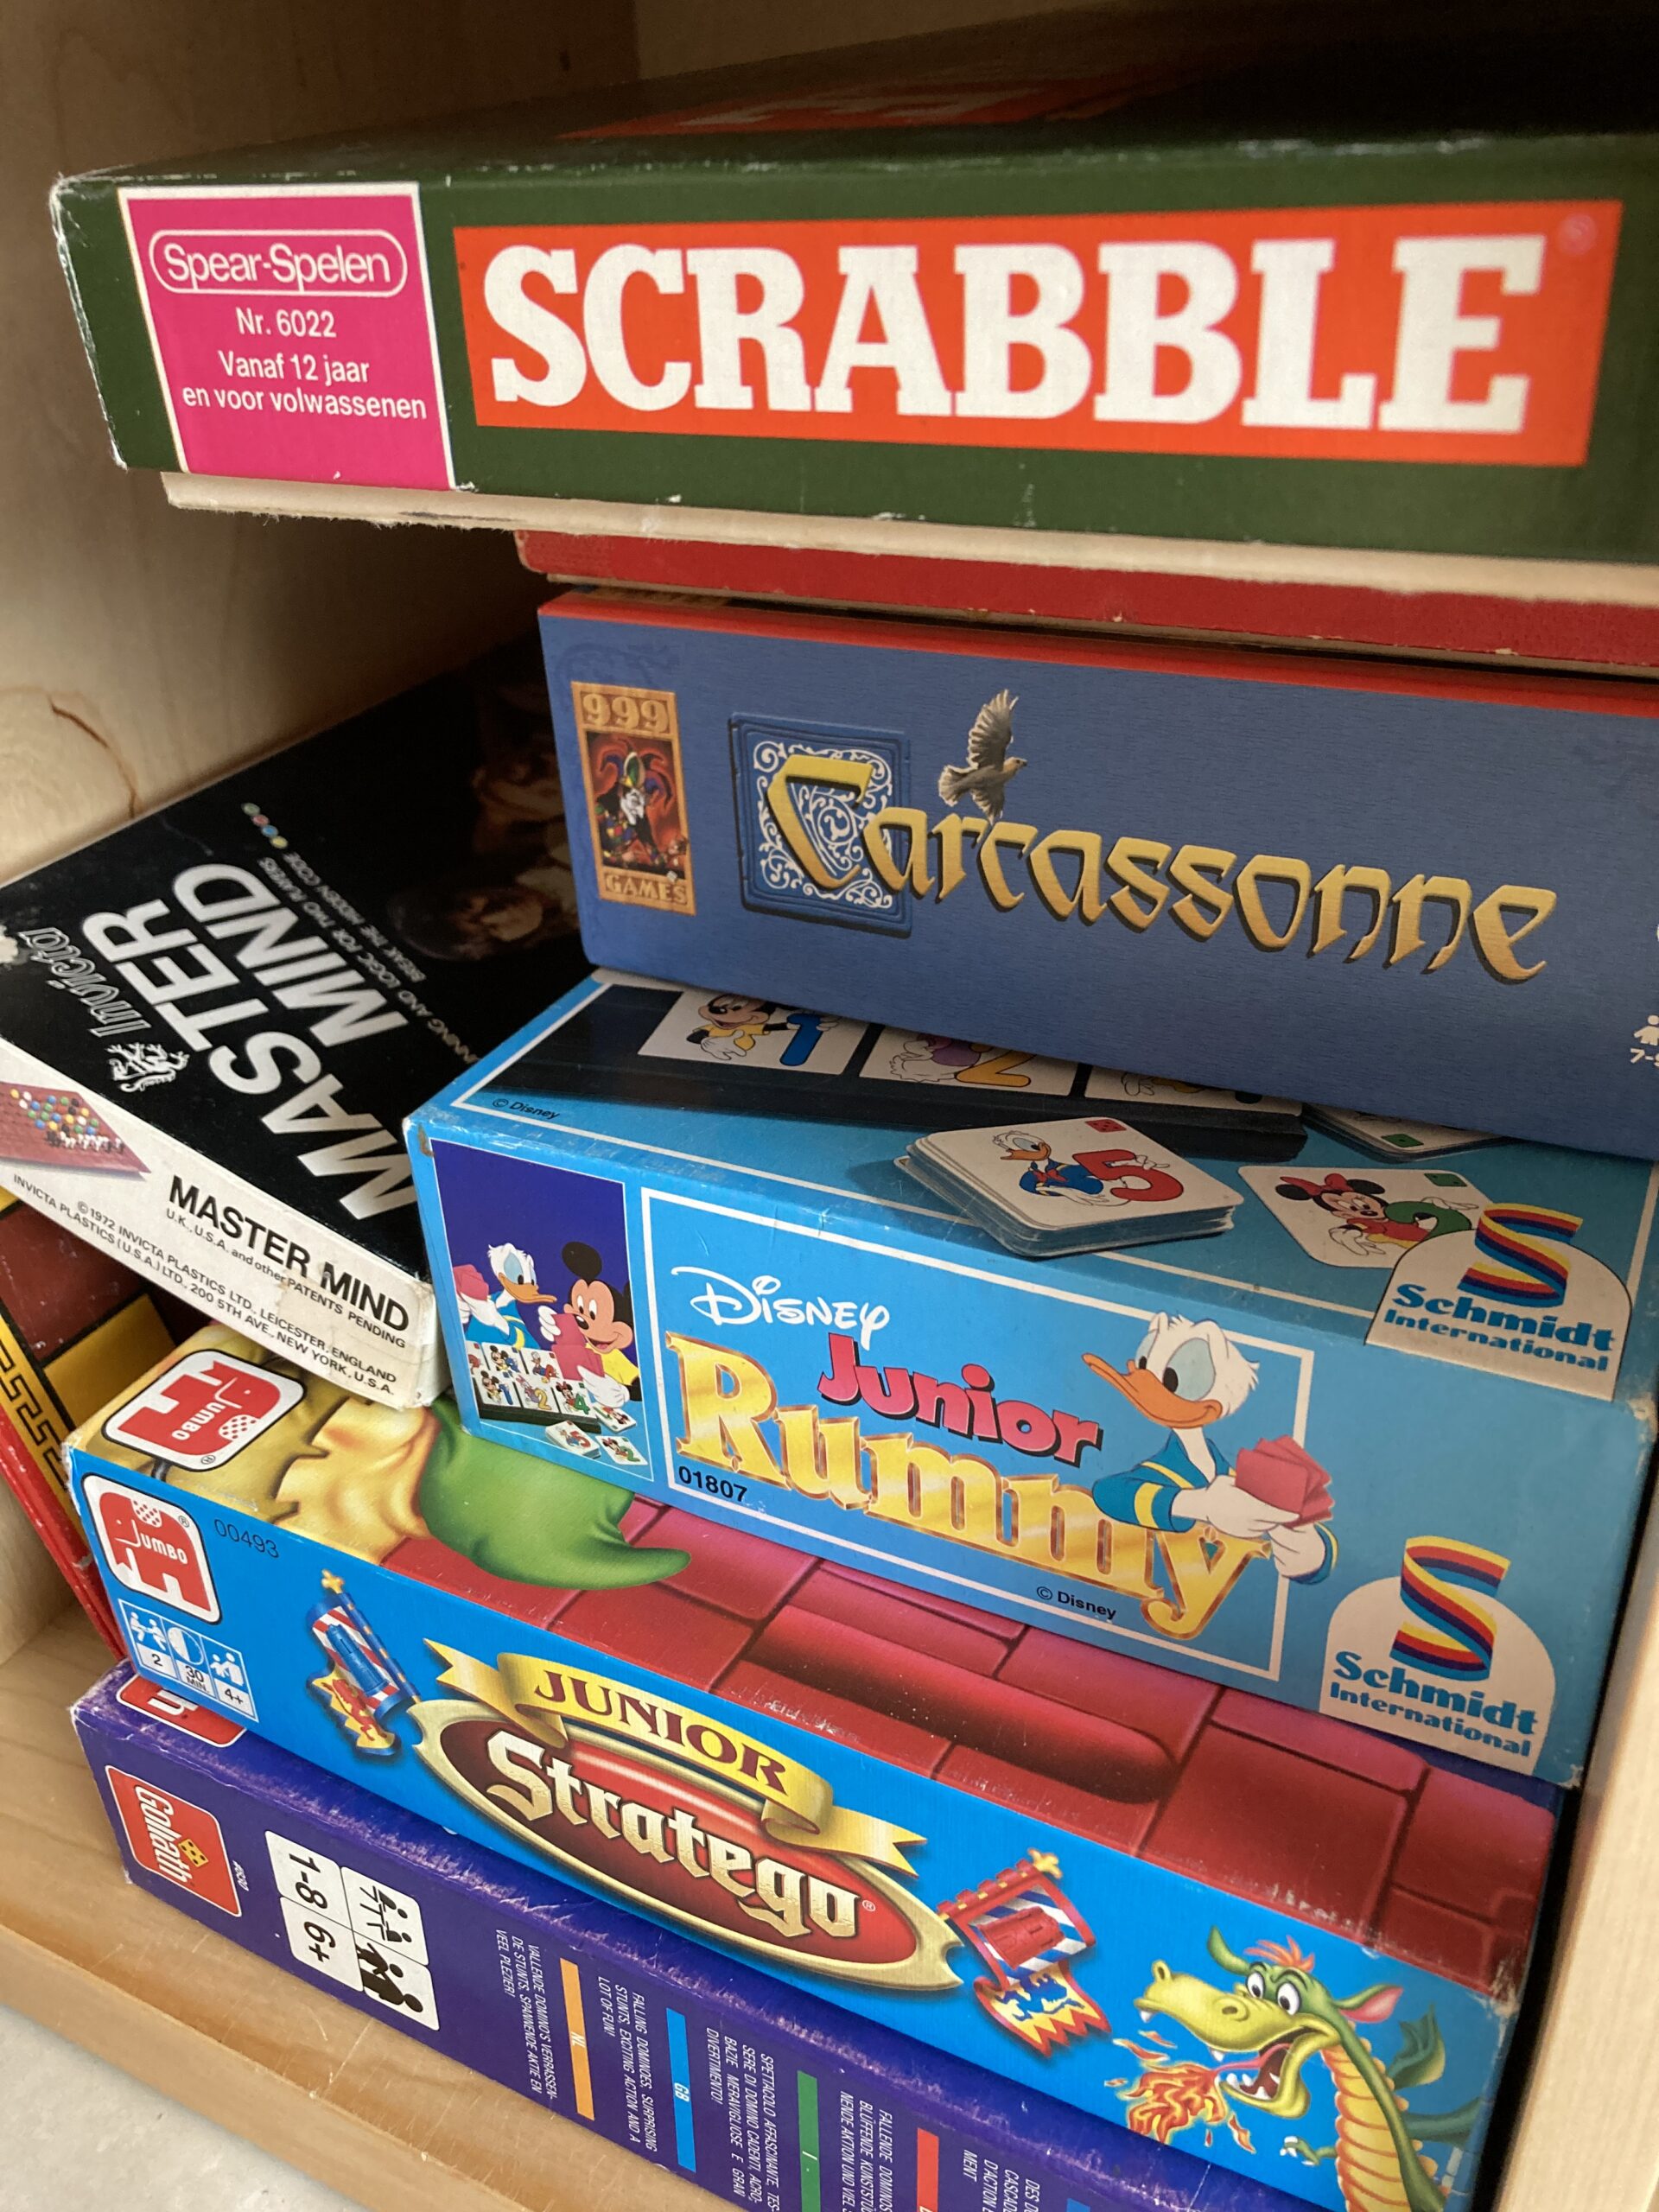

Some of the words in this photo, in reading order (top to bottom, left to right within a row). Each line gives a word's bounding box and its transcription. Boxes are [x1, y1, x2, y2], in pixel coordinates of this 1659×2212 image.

[163, 243, 391, 291] Spear-Spelen
[235, 307, 271, 336] Nr.
[276, 309, 337, 338] 6022
[482, 234, 1547, 434] SCRABBLE
[218, 350, 285, 379] Vanaf
[290, 354, 318, 381] 12
[323, 358, 370, 386] jaar
[182, 385, 210, 407] en
[213, 390, 264, 412] voor
[270, 387, 427, 419] volwassenen
[582, 693, 670, 734] 999
[766, 753, 1556, 985] Carcassonne
[606, 874, 688, 904] GAMES
[173, 863, 409, 1048] MIND
[82, 898, 419, 1221] MASTER
[509, 1101, 561, 1120] Disney
[168, 1174, 311, 1279] MASTER
[320, 1262, 409, 1332] MIND
[13, 1174, 57, 1209] INVICTA
[60, 1203, 116, 1244] PLASTICS
[190, 1282, 214, 1304] 200
[217, 1298, 242, 1319] 5TH
[277, 1332, 308, 1354] NEW
[353, 1372, 395, 1396] U.S.A.
[118, 1225, 164, 1261] INVICTA
[168, 1255, 226, 1296] PLASTICS
[331, 1346, 397, 1383] ENGLAND
[232, 1249, 254, 1267] and
[254, 1262, 287, 1283] other
[287, 1276, 343, 1316] PATENTS
[347, 1311, 406, 1350] PENDING
[1391, 1282, 1615, 1351] Schmidt
[1383, 1308, 1609, 1372] International
[817, 1332, 1104, 1467] Junior
[665, 1332, 1272, 1640] Rummy
[677, 1465, 747, 1503] 01807
[214, 1519, 279, 1558] 00493
[1058, 1590, 1117, 1621] Disney
[151, 1654, 163, 1667] 2
[185, 1665, 204, 1682] 30
[224, 1688, 244, 1705] 4+
[1332, 1649, 1538, 1736] Schmidt
[534, 1670, 790, 1796] JUNIOR
[1329, 1681, 1532, 1758] International
[486, 1729, 860, 1940] Stratego
[289, 1853, 327, 1909] 1-8
[303, 1921, 336, 1962] 6+
[496, 1929, 510, 1955] VEEL
[512, 1936, 524, 1952] DE
[528, 1944, 545, 1994] VALLENDE
[598, 1976, 612, 2000] LOT
[519, 1993, 537, 2050] SPANNENDE
[600, 1997, 613, 2012] OF
[570, 2031, 586, 2049] NL
[619, 2027, 635, 2075] EXCITING
[724, 2036, 738, 2069] BAZIE
[742, 2044, 756, 2074] SERE
[527, 2050, 541, 2080] AKTIE
[632, 1992, 647, 2035] FALLING
[641, 2093, 658, 2152] SURPRISING
[744, 2072, 757, 2084] DI
[530, 2078, 543, 2094] EN
[623, 2073, 639, 2116] ACTION
[674, 2082, 690, 2102] GB
[760, 2053, 776, 2117] SPETTACOLO
[627, 2110, 641, 2134] AND
[726, 2074, 743, 2149] MERAVIGLIOSE
[744, 2083, 759, 2129] DOMINO
[840, 2090, 854, 2128] NENDE
[629, 2133, 641, 2144] A
[841, 2126, 855, 2164] AKTION
[879, 2108, 893, 2163] FALLENDE
[732, 2166, 746, 2198] GRAN
[842, 2163, 855, 2187] UND
[963, 2149, 978, 2183] MENT
[842, 2186, 855, 2207] VIEL
[1025, 2178, 1040, 2203] DES
